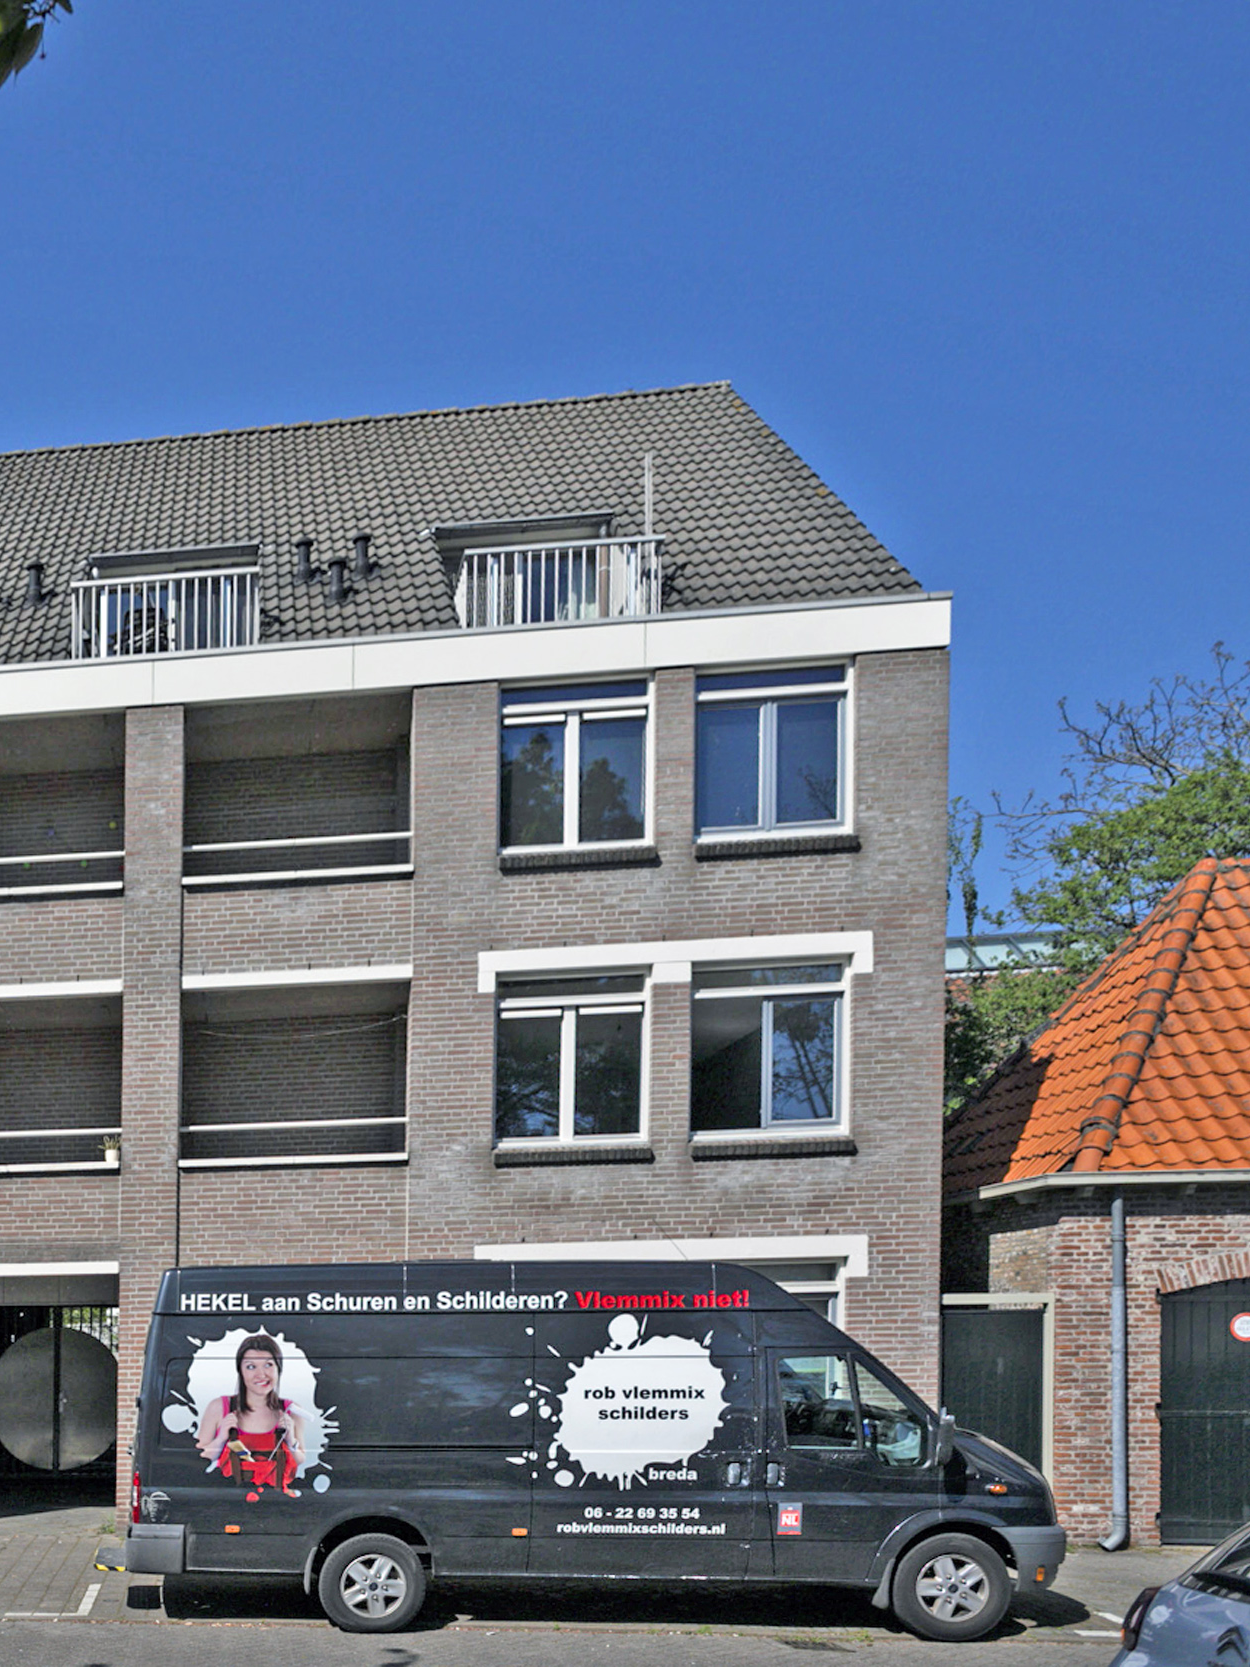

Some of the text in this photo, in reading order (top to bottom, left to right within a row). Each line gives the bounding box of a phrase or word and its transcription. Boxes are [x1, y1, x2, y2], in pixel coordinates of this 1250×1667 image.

[180, 1289, 750, 1312] HEKEL aan Schuren en Schilderen? Vlemmix niet!
[584, 1385, 705, 1399] rob vlemmix
[598, 1406, 689, 1420] schilders
[648, 1467, 698, 1481] breda
[584, 1507, 603, 1519] 06
[614, 1507, 634, 1520] 22
[637, 1507, 656, 1520] 69
[659, 1507, 678, 1519] 35
[681, 1507, 700, 1519] 54
[556, 1522, 726, 1535] robvlemmixschilders.nl
